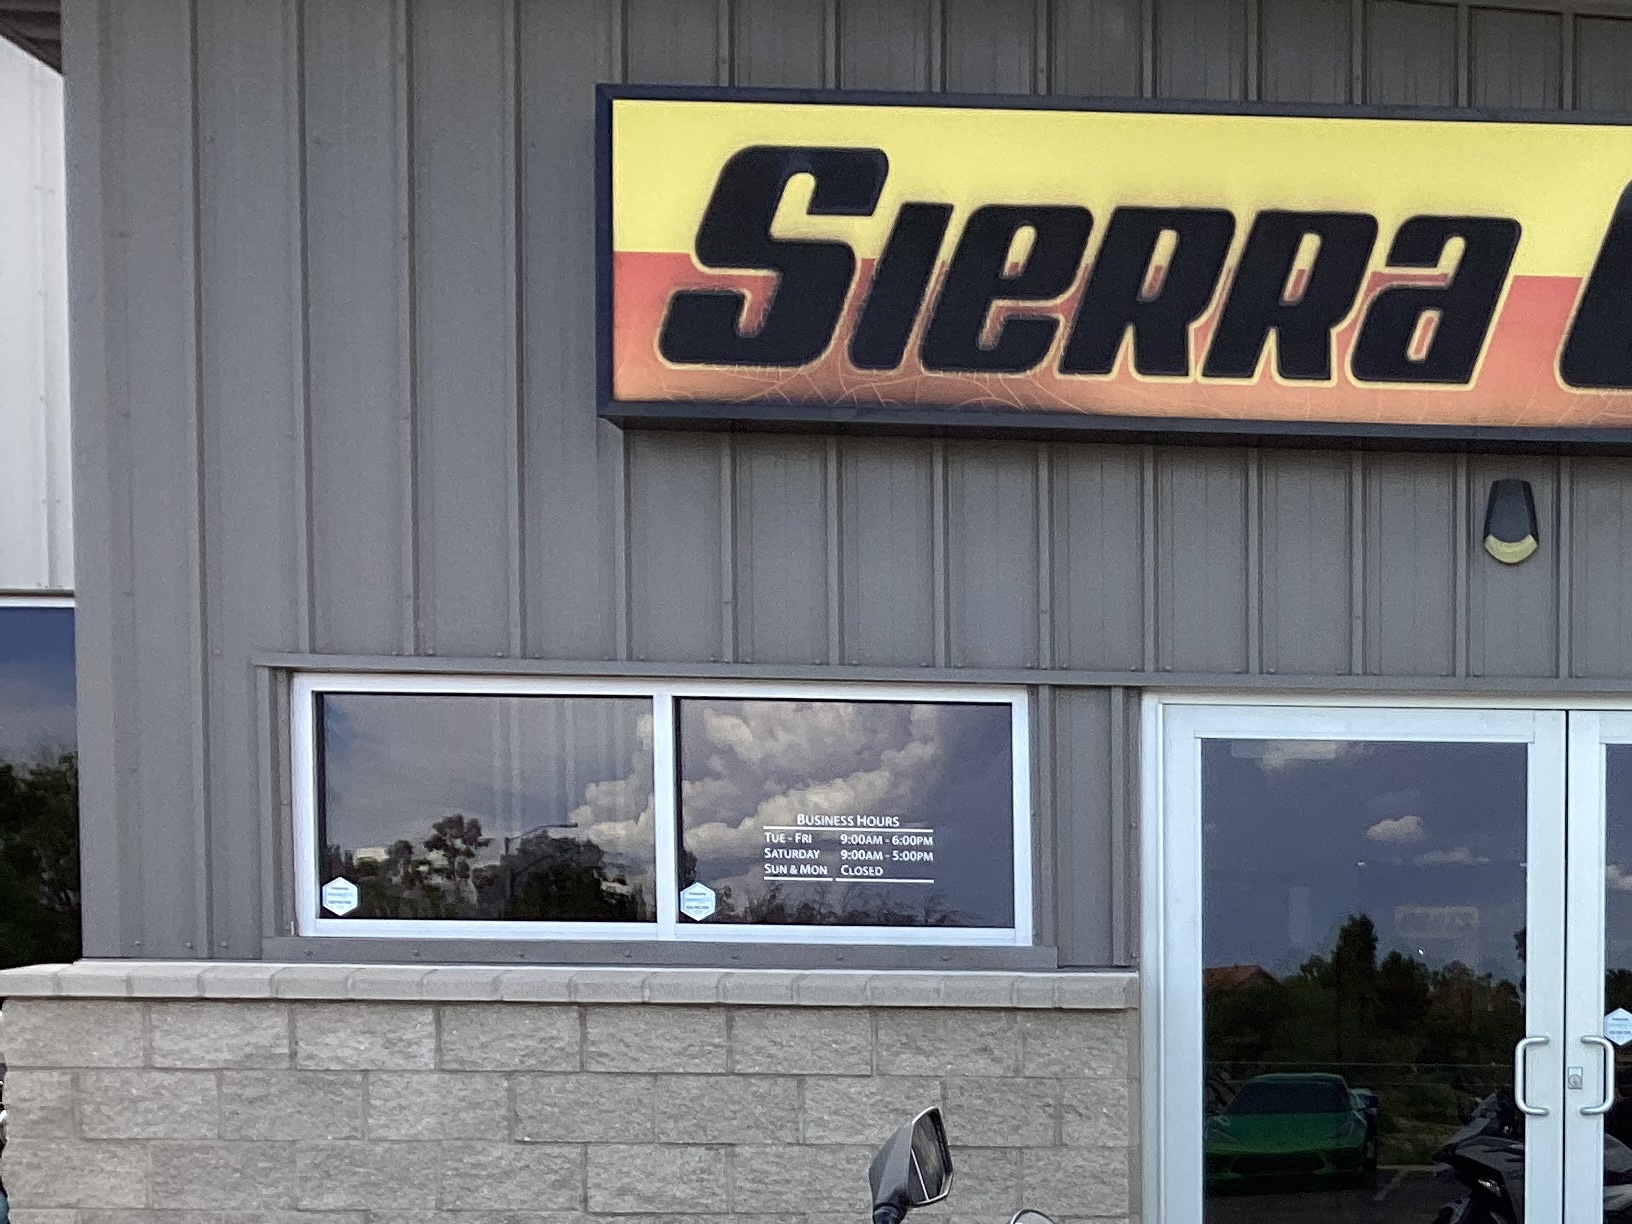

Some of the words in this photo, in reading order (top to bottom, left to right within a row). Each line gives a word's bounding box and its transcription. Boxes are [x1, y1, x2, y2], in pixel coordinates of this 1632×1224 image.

[796, 813, 854, 827] BUSINESS
[856, 815, 900, 828] HOURS
[764, 832, 786, 844] TUE
[794, 833, 812, 844] FRI
[840, 834, 883, 845] 9:00AM
[891, 835, 933, 846] 6:00PM
[764, 847, 820, 859] SATURDAY
[840, 849, 883, 861] 9:00AM
[892, 850, 934, 862] 5:00PM
[764, 863, 787, 875] SUN
[789, 865, 798, 875] &
[799, 864, 828, 875] MON
[840, 864, 884, 876] CLOSED
